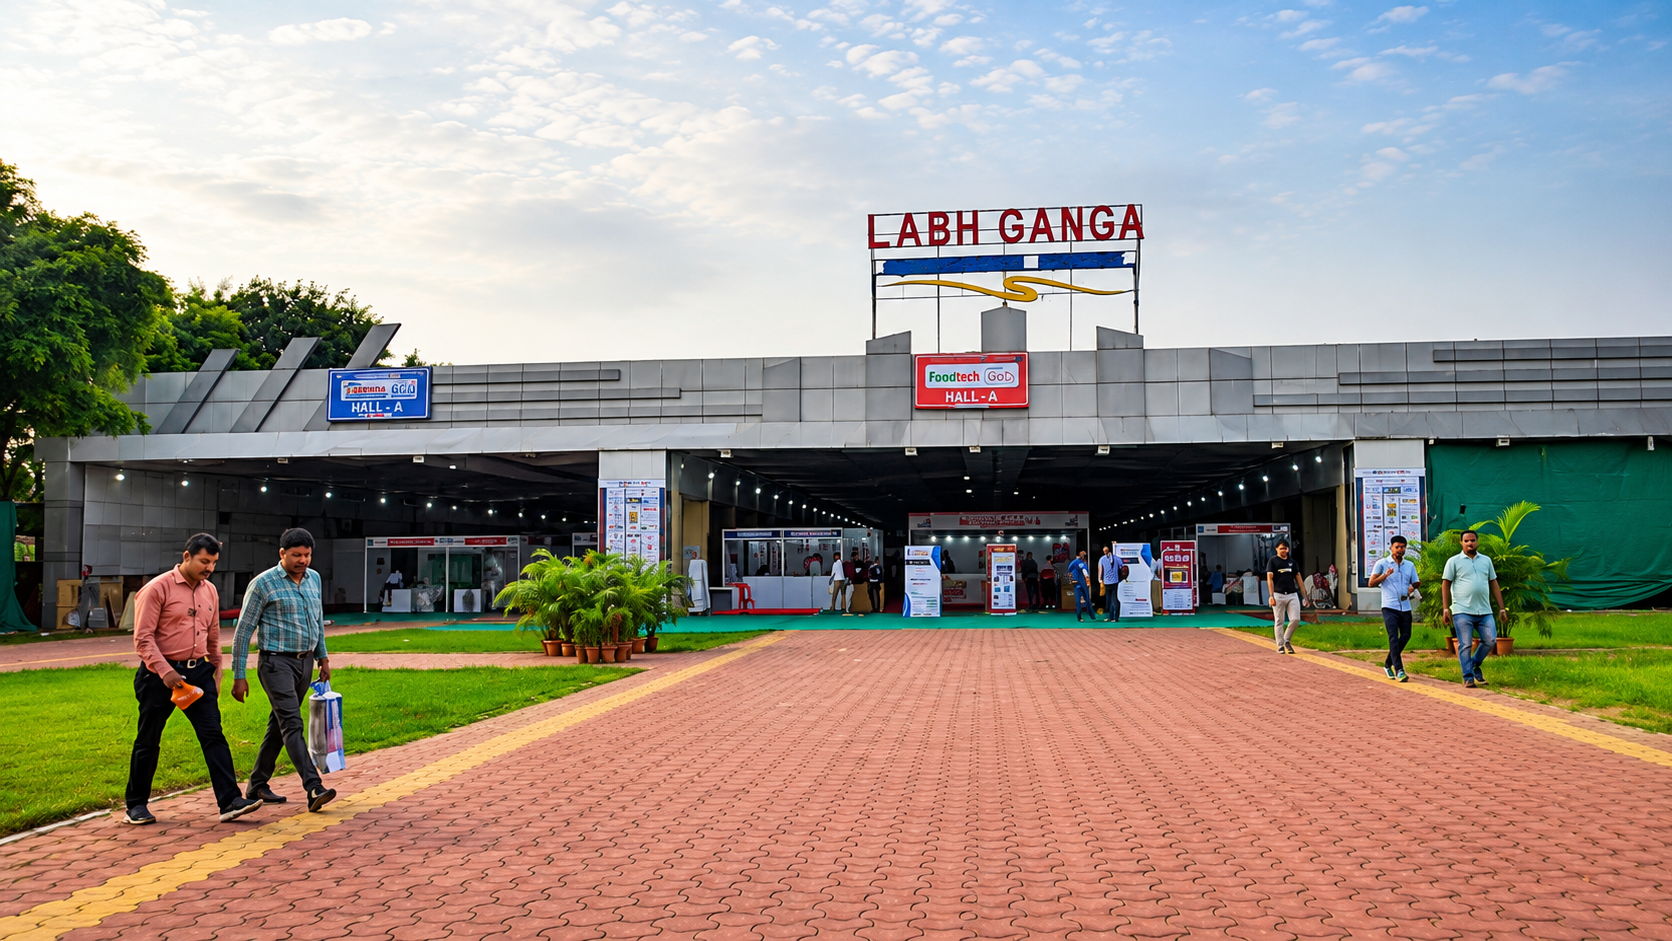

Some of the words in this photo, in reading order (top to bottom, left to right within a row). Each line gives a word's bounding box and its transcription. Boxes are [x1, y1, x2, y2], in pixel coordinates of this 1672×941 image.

[868, 210, 979, 249] LABH
[999, 204, 1144, 243] GANGA
[929, 370, 980, 382] Foodtech
[351, 401, 383, 413] HALL
